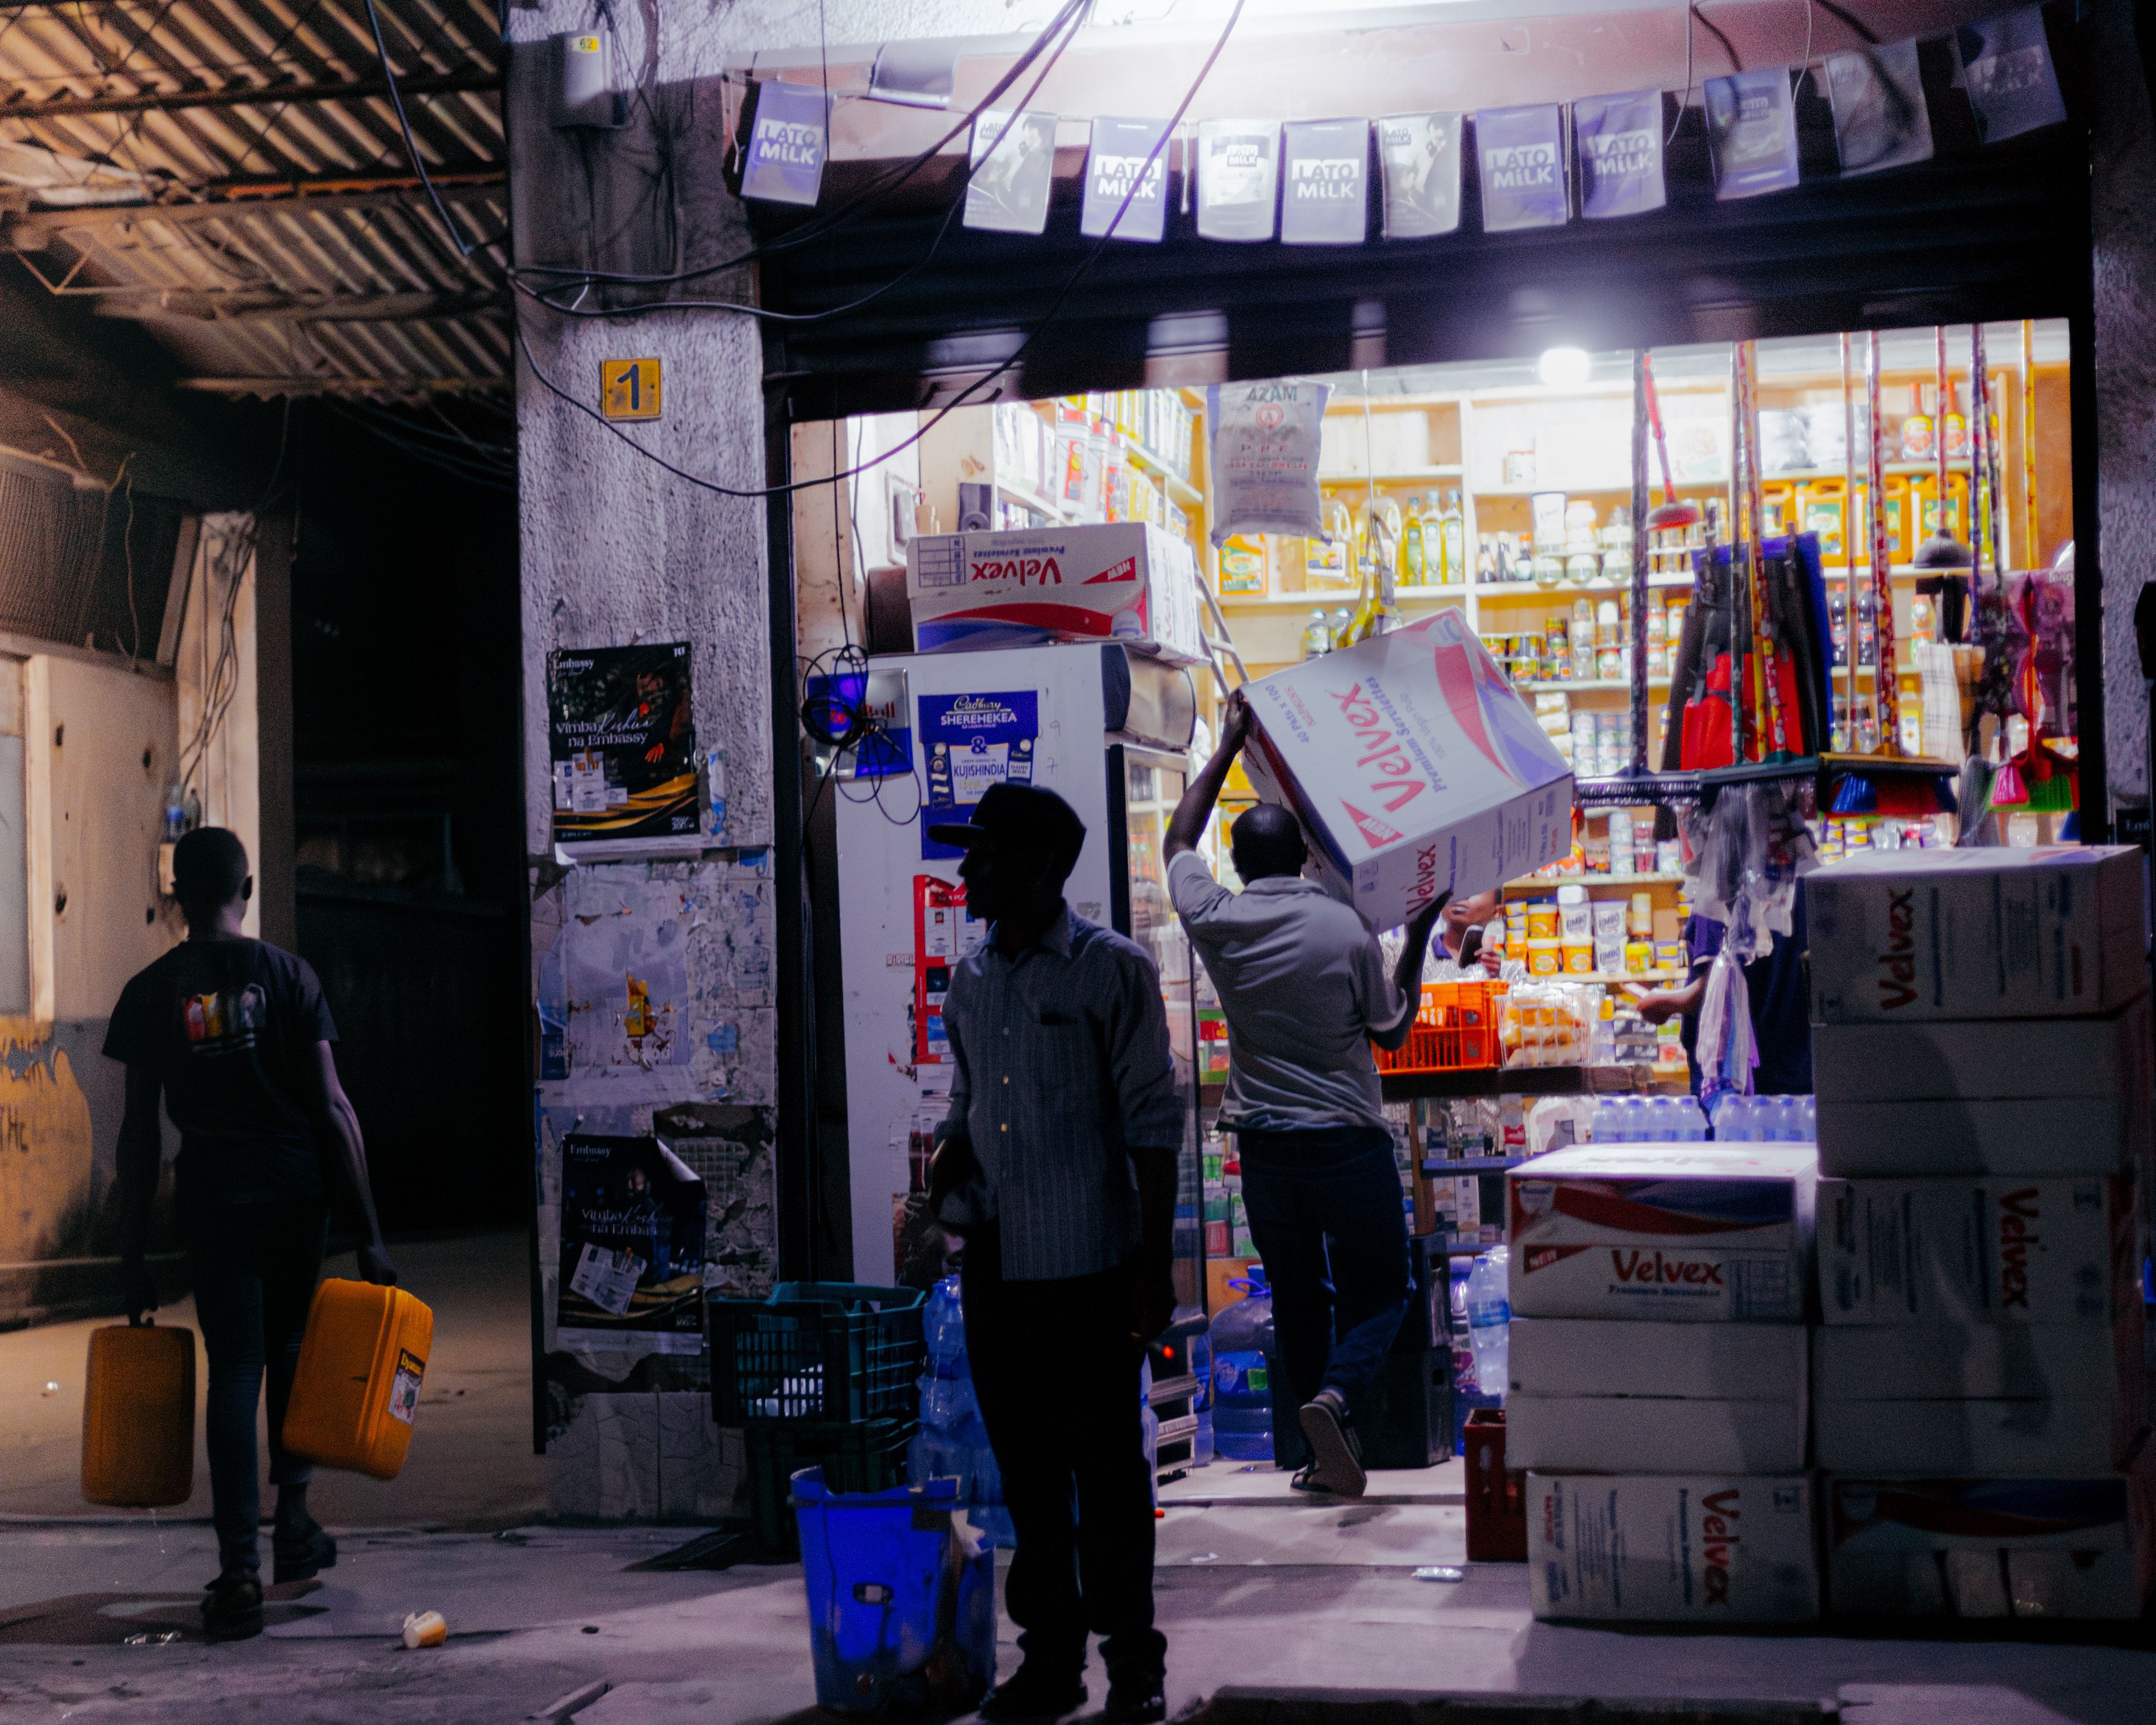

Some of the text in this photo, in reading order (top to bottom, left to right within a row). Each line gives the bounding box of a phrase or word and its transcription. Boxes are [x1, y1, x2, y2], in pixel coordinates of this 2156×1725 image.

[763, 123, 817, 146] LATO
[1591, 133, 1651, 156] LATO
[1492, 148, 1550, 168] LATO
[1298, 163, 1355, 180] LATO
[617, 364, 639, 411] 1
[1246, 385, 1298, 403] AZAM
[971, 556, 1063, 587] Velvex
[1107, 560, 1132, 581] NEW
[953, 695, 1001, 711] Cadbury
[1265, 684, 1281, 702] 100
[940, 712, 1017, 726] SHEREHEKEA
[568, 732, 649, 748] na Embassy
[971, 735, 988, 754] &
[1297, 730, 1310, 743] 40
[1365, 675, 1447, 793] Premium Serviettes
[1330, 682, 1427, 813] Velvex
[953, 763, 1006, 779] KUJISHINDIA
[1358, 817, 1396, 840] NEW
[1405, 843, 1437, 916] Velvex
[1878, 888, 1918, 1011] Velvex
[1998, 1187, 2040, 1310] Velvex
[1611, 1249, 1724, 1286] Velvex
[1702, 1489, 1741, 1607] Velvex
